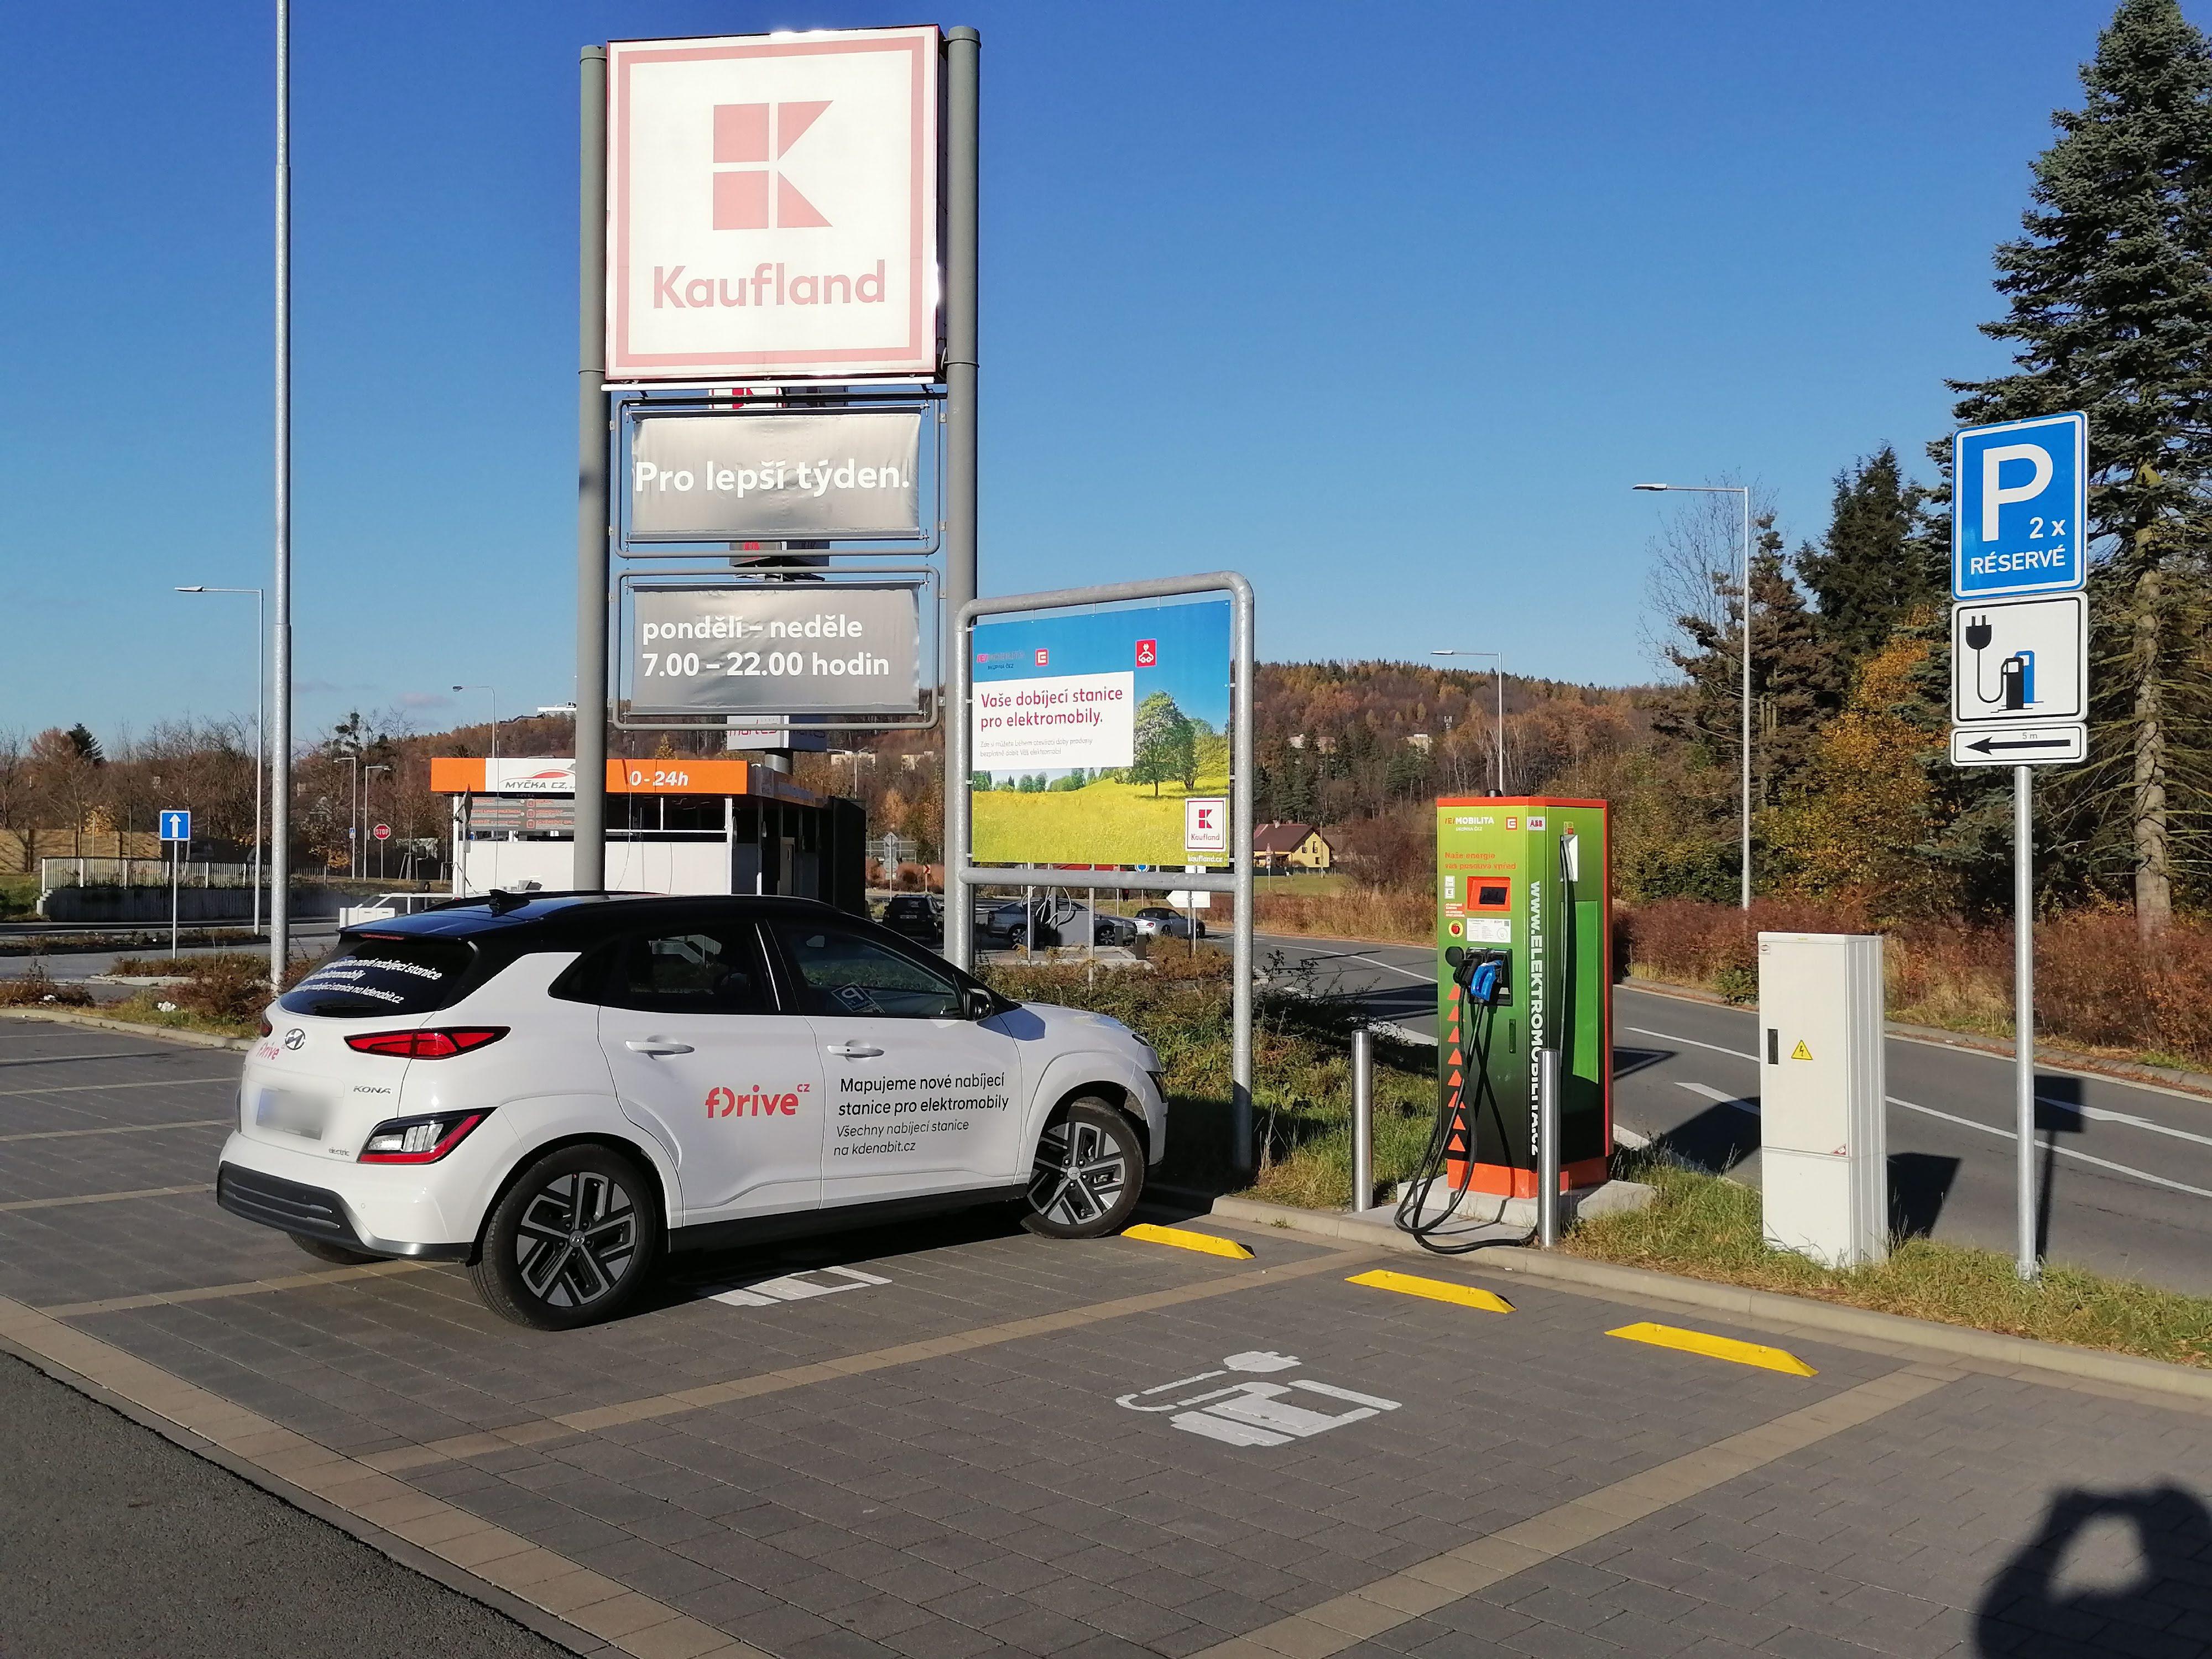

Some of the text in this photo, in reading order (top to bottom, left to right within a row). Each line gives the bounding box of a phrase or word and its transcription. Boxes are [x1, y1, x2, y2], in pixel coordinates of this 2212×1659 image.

[654, 259, 885, 309] Kaufland
[635, 458, 909, 498] Pro lepší týden.
[1983, 444, 2053, 542] P
[2029, 517, 2043, 539] 2
[1970, 545, 2065, 575] RÉSERVÉ
[643, 615, 742, 645] pondělí
[770, 615, 863, 638] neděle
[642, 652, 700, 676] 7.00
[727, 651, 804, 676] 22.00
[812, 651, 889, 675] hodin
[981, 686, 1123, 708] Vaše dobíjecí stanice
[981, 708, 1103, 732] pro elektromobily.
[505, 780, 546, 789] MYČKA
[1187, 854, 1223, 863] kaufland.cz
[404, 965, 442, 980] stanice
[353, 1085, 392, 1094] KONA
[840, 1072, 1005, 1095] Mapujeme nové nabíjecí
[705, 1085, 799, 1119] fDrive
[838, 1095, 1009, 1117] stanice pro elektromobily
[836, 1119, 969, 1138] Všechny nabíjecí stanice
[833, 1141, 916, 1156] na kdenabit.cz
